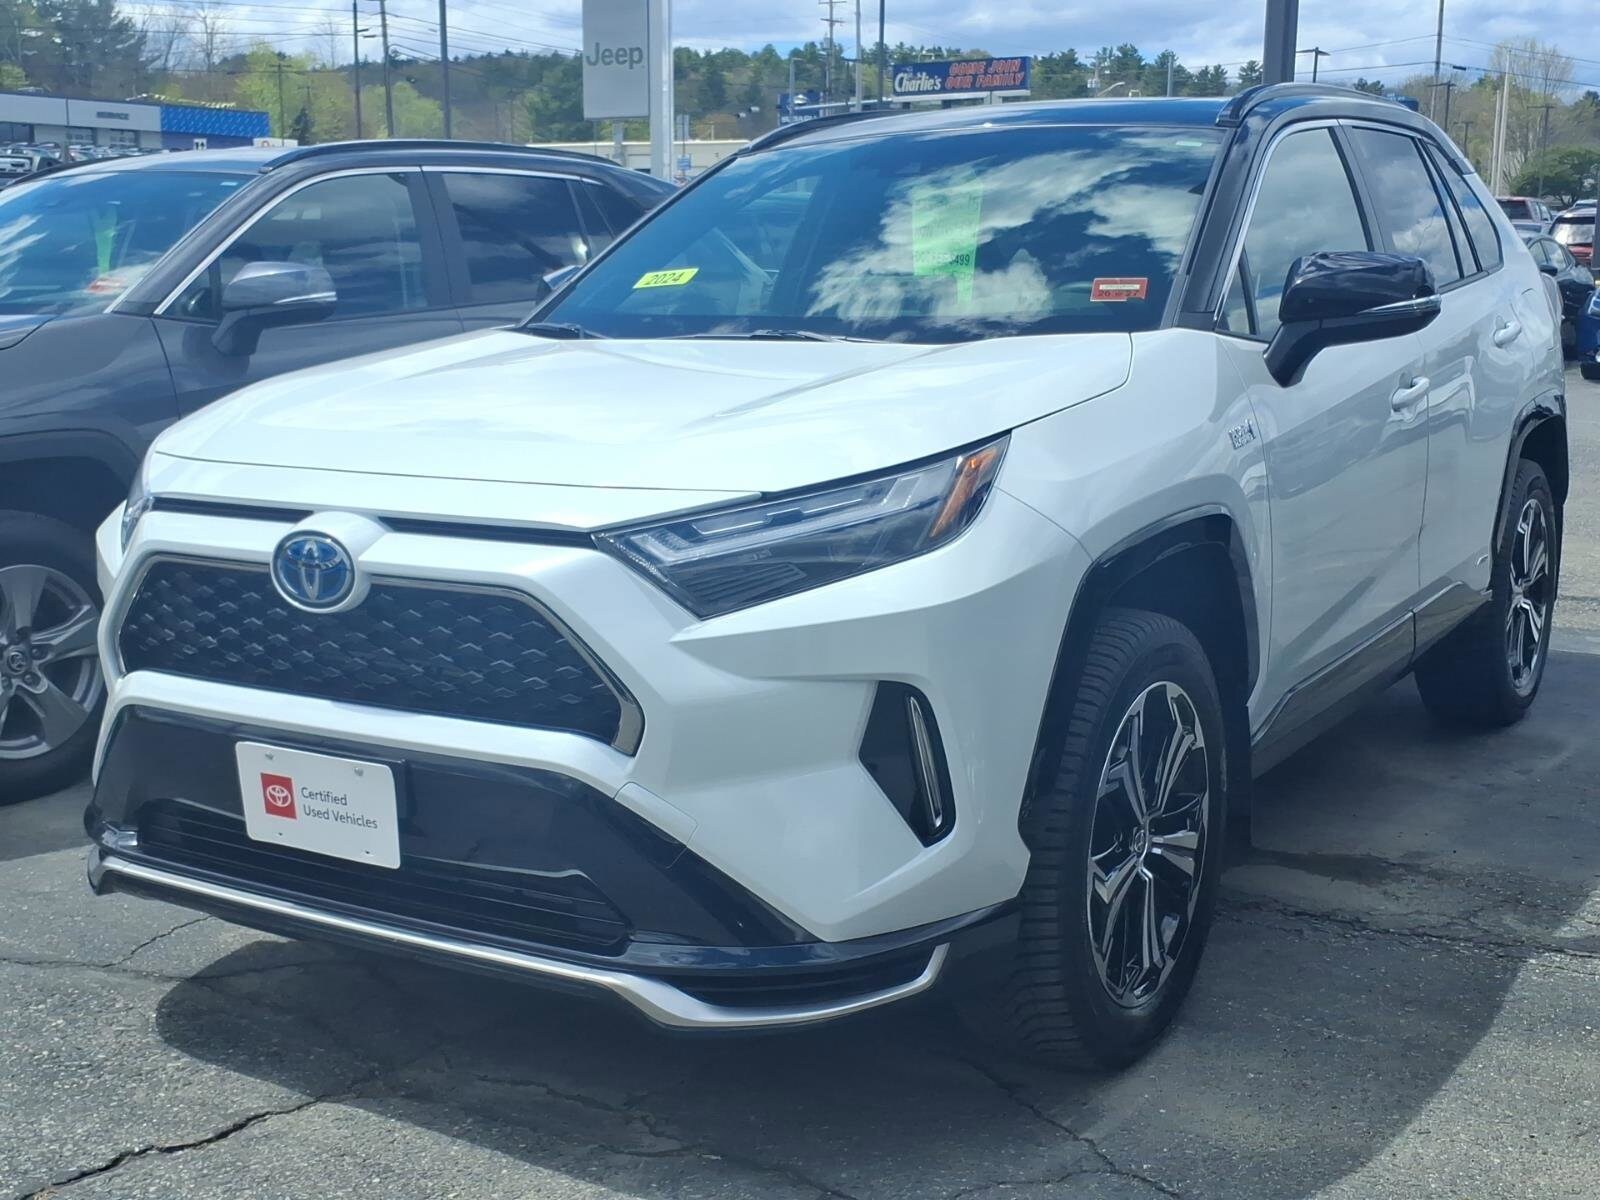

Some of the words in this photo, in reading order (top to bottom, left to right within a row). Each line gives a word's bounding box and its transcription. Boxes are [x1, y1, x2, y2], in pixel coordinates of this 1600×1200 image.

[585, 41, 644, 70] Jeep
[949, 61, 986, 75] COME
[987, 59, 1022, 74] JOIN
[894, 72, 942, 93] Charlie's
[944, 75, 973, 90] OUR
[975, 72, 1025, 88] FAMILY
[643, 271, 685, 285] 2024
[301, 787, 348, 806] Certified
[303, 804, 330, 820] Used
[331, 810, 378, 829] Vehicles
